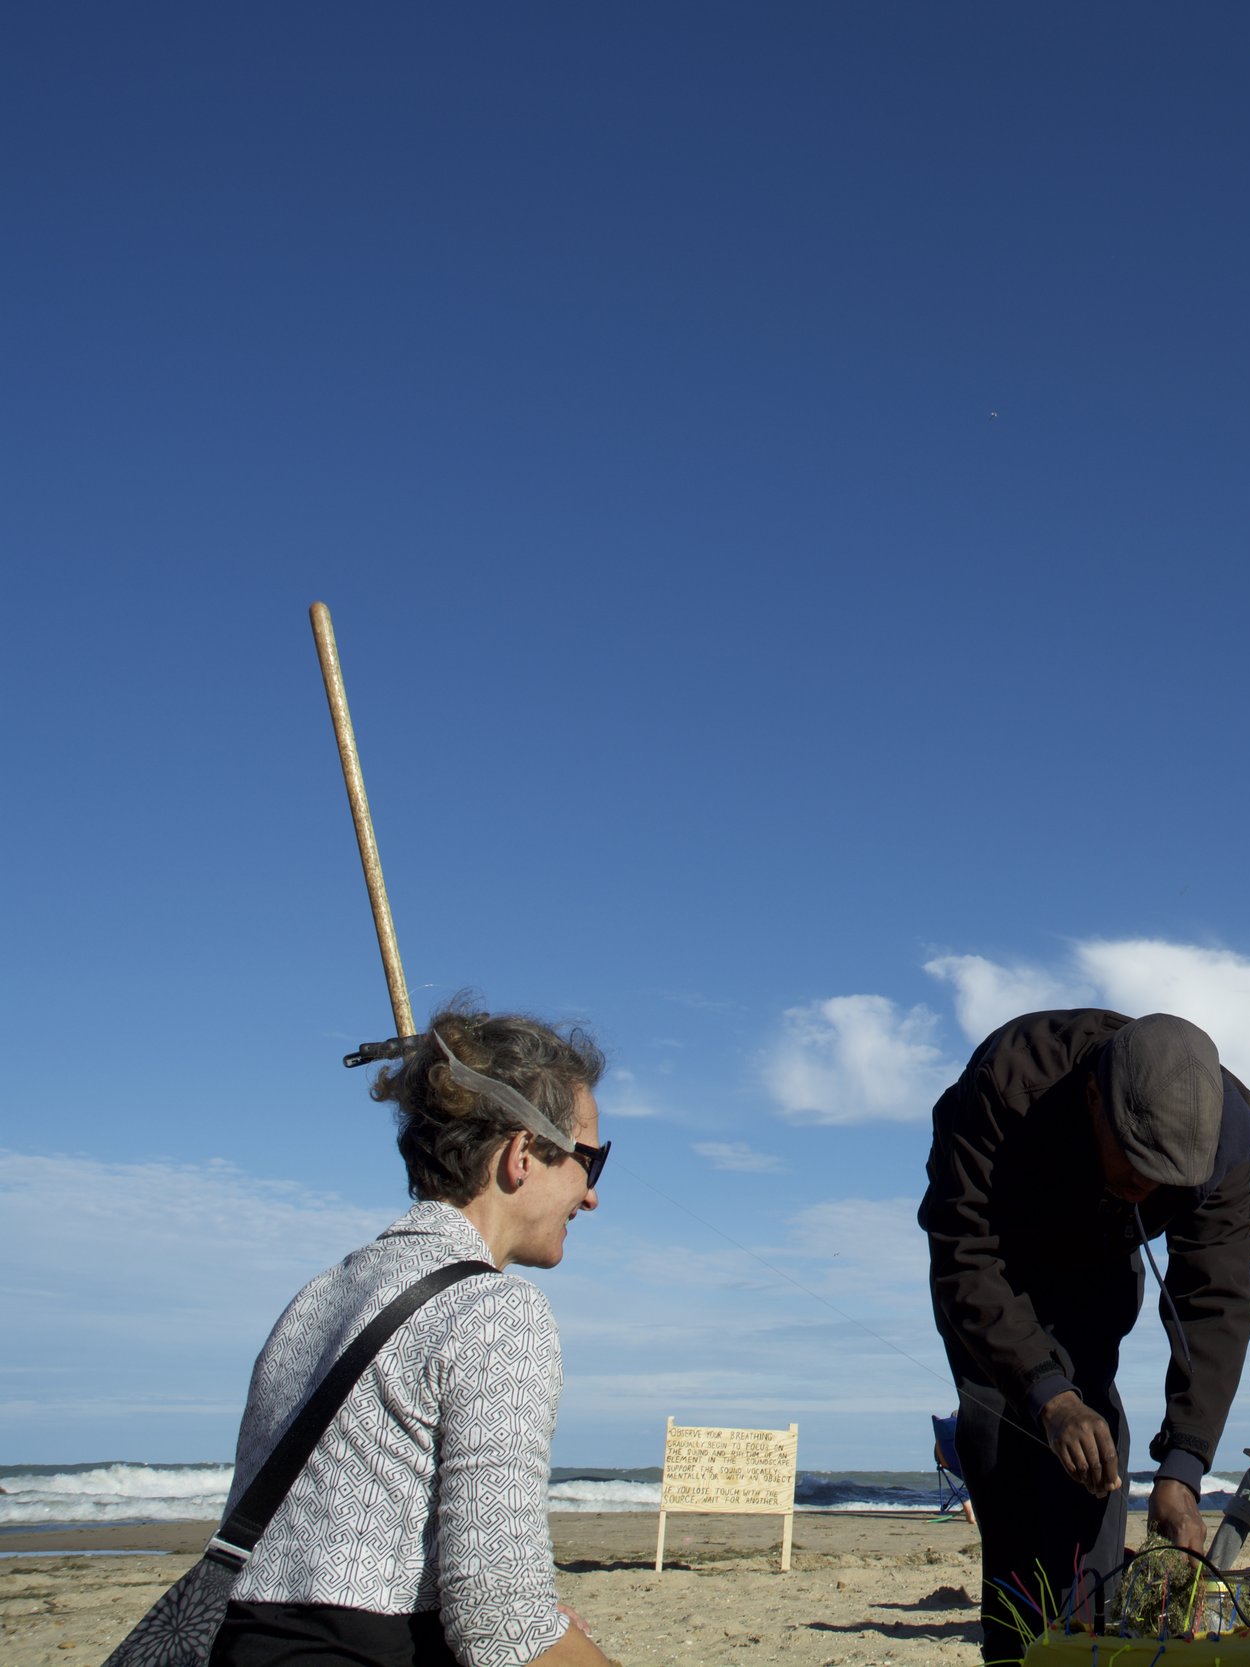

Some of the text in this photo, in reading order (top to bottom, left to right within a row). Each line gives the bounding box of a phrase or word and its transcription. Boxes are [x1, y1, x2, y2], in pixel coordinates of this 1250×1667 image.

[706, 1430, 722, 1438] YOUR
[730, 1432, 773, 1441] BREATHING
[746, 1443, 769, 1451] FOCUS
[716, 1488, 740, 1496] TOUCH
[664, 1495, 698, 1504] SOURCE,
